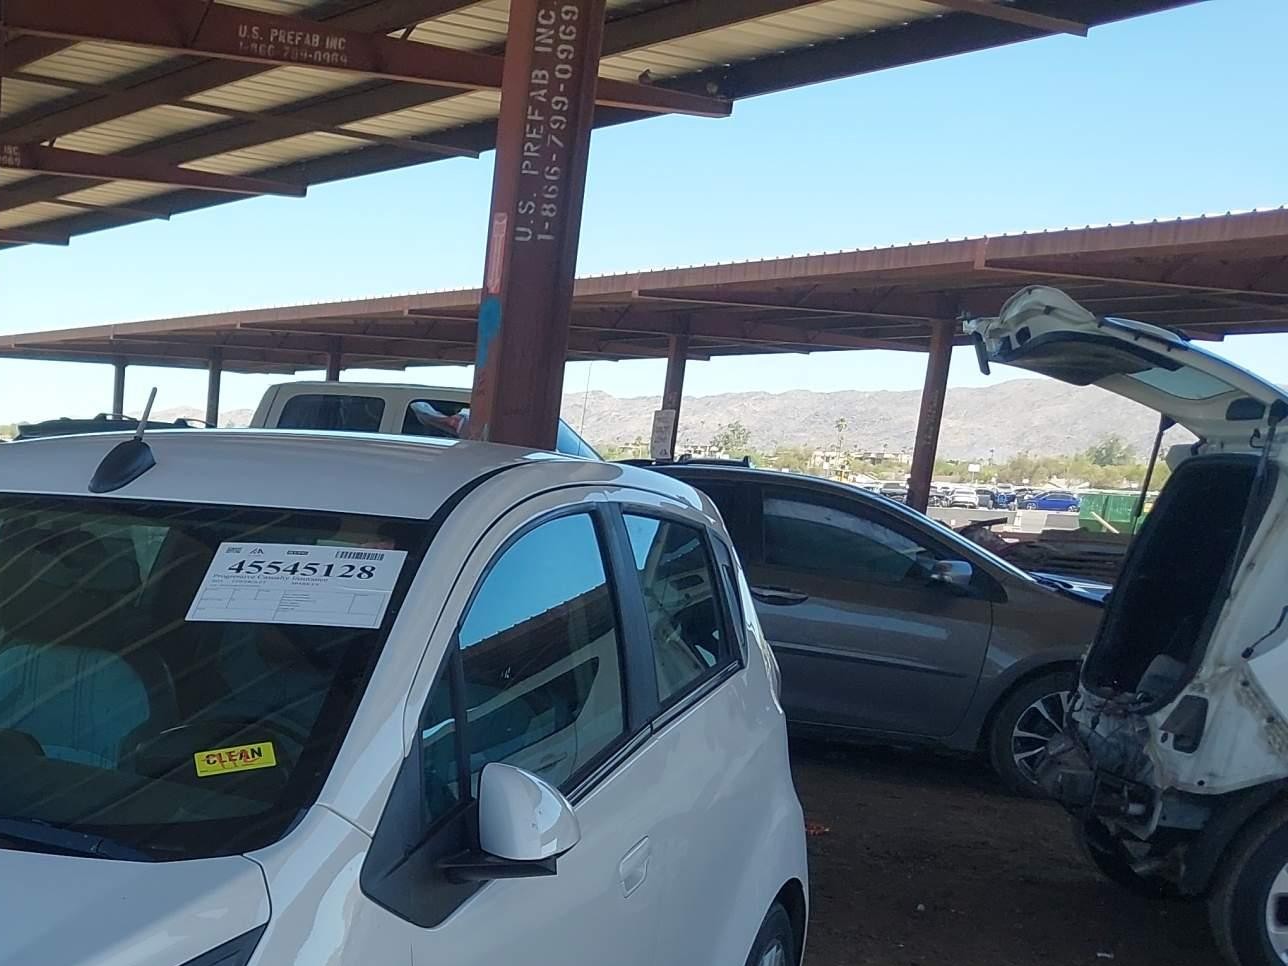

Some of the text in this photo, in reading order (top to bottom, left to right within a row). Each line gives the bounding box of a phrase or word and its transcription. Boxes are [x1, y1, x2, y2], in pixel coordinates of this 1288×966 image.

[238, 24, 347, 50] U.S. PREFAB INC
[521, 68, 550, 176] PREFAB
[537, 4, 579, 241] 1-866-799-0969
[515, 192, 537, 242] U.S.
[228, 559, 376, 580] 45545128
[206, 747, 263, 765] CLEAN
